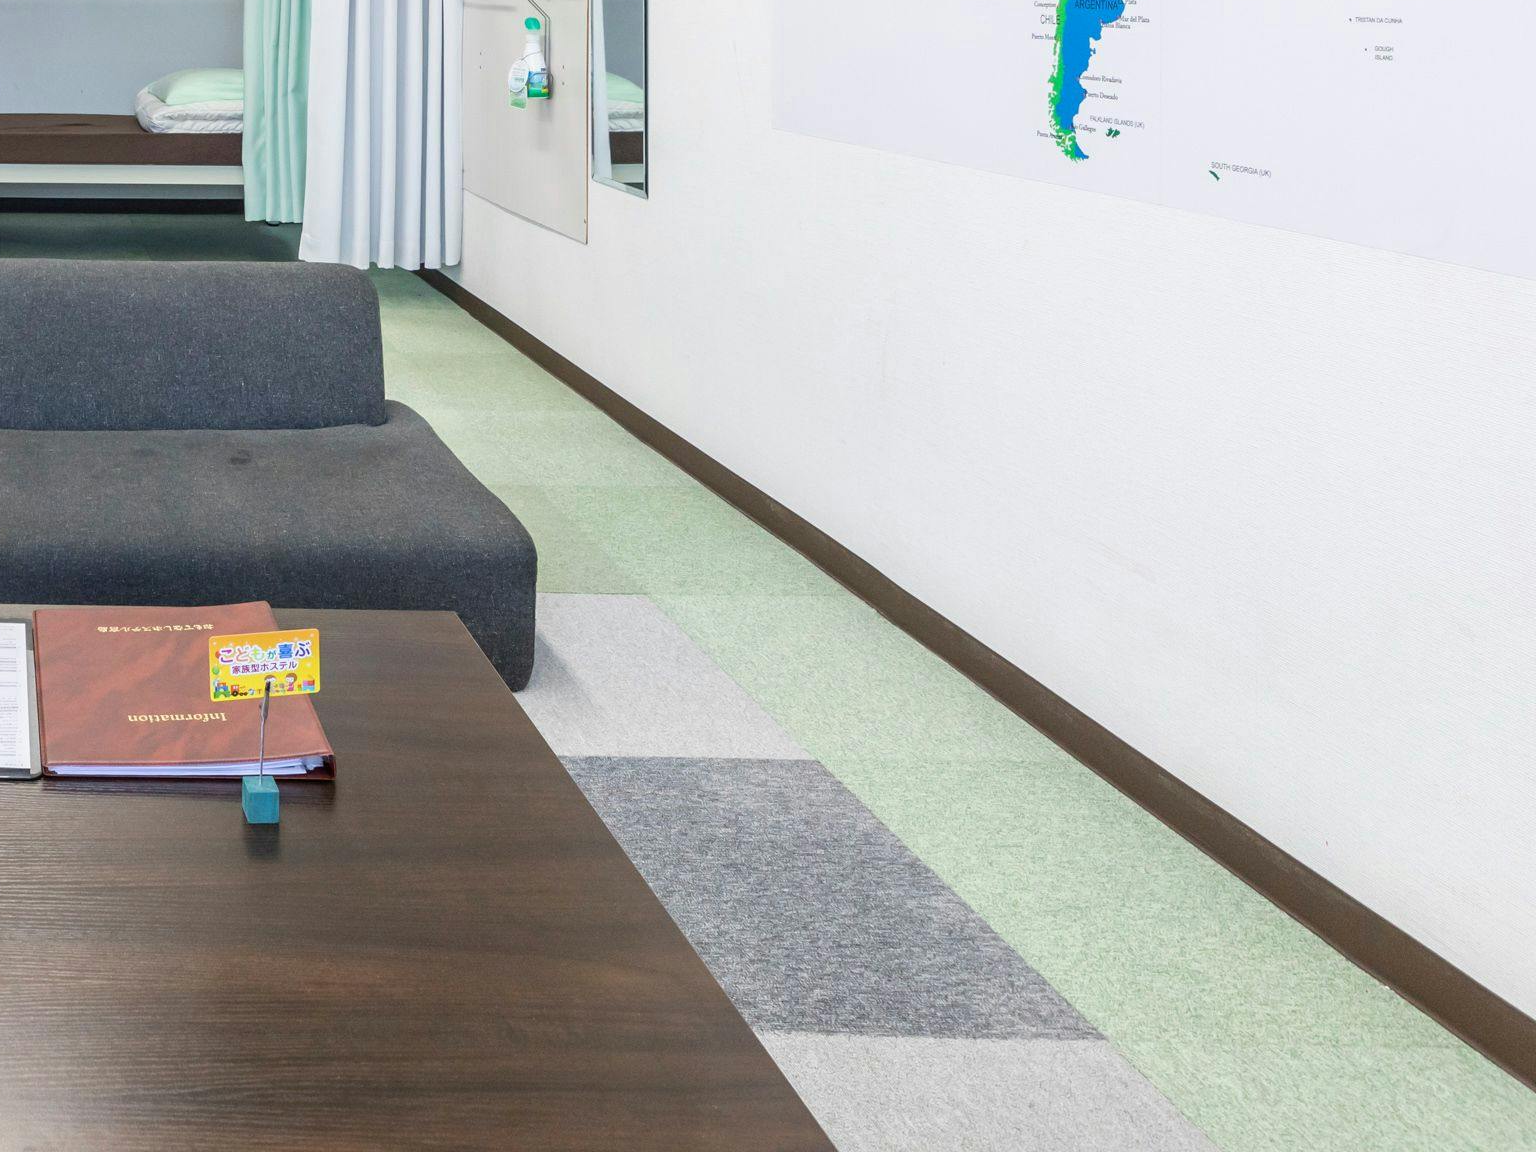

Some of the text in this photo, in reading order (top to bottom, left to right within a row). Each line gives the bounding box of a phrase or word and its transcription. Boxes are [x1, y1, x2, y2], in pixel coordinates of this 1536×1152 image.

[1075, 0, 1119, 11] ARGENTINA
[1040, 14, 1061, 25] CHILE
[1210, 161, 1272, 179] SOUTH GEORGIA (UK)
[219, 641, 312, 664] こどもが喜ぶ
[231, 660, 298, 674] 家族型ホステル
[127, 712, 227, 723] Information
